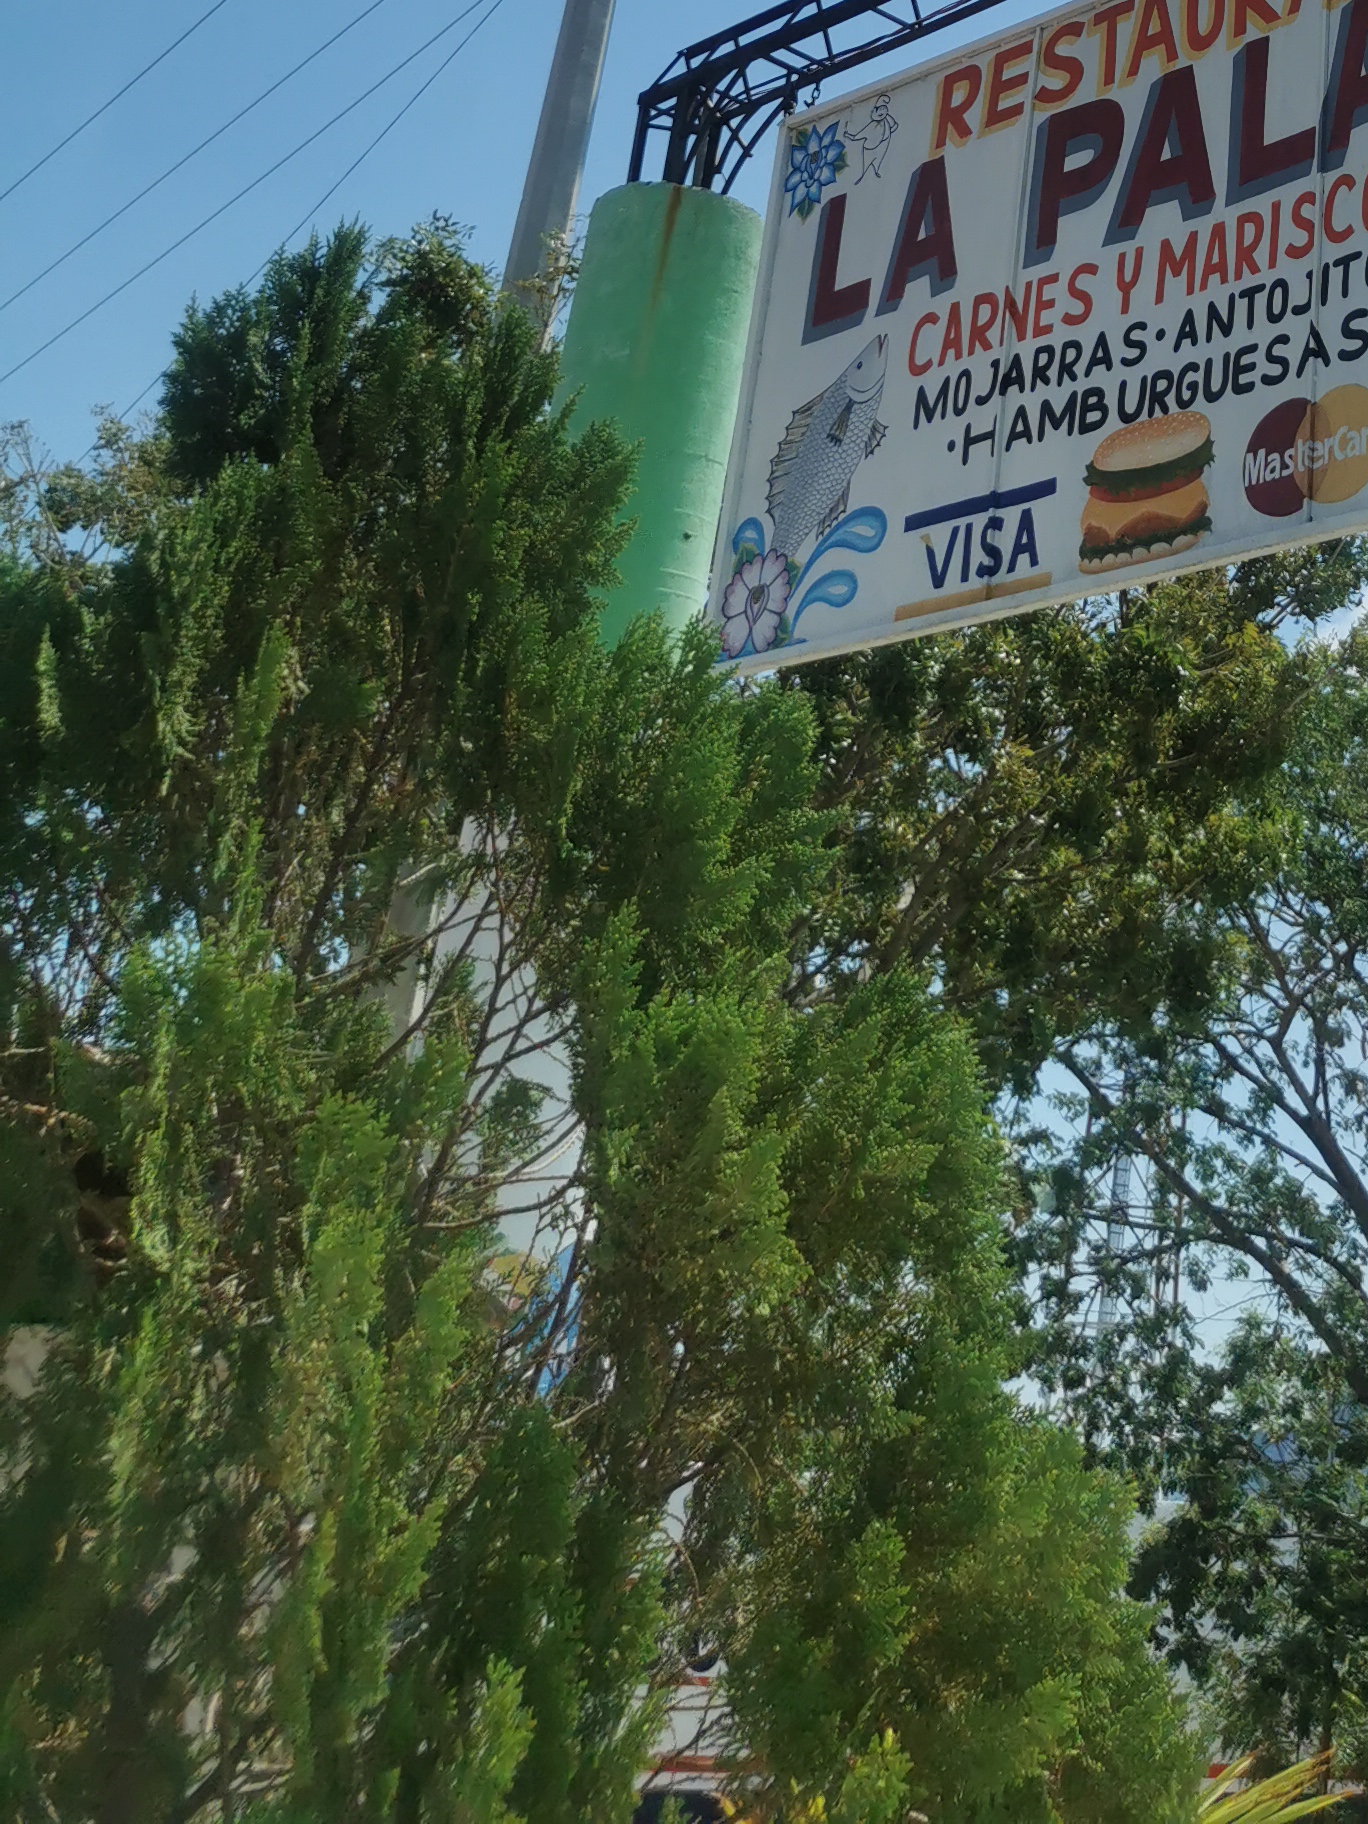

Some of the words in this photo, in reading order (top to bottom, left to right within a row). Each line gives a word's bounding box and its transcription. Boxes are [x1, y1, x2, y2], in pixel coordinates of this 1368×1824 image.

[803, 155, 961, 344] LA
[908, 262, 1099, 377] CARNES
[1115, 245, 1144, 315] Y
[912, 321, 1148, 430] MOJARRAS
[921, 507, 1040, 590] VISA
